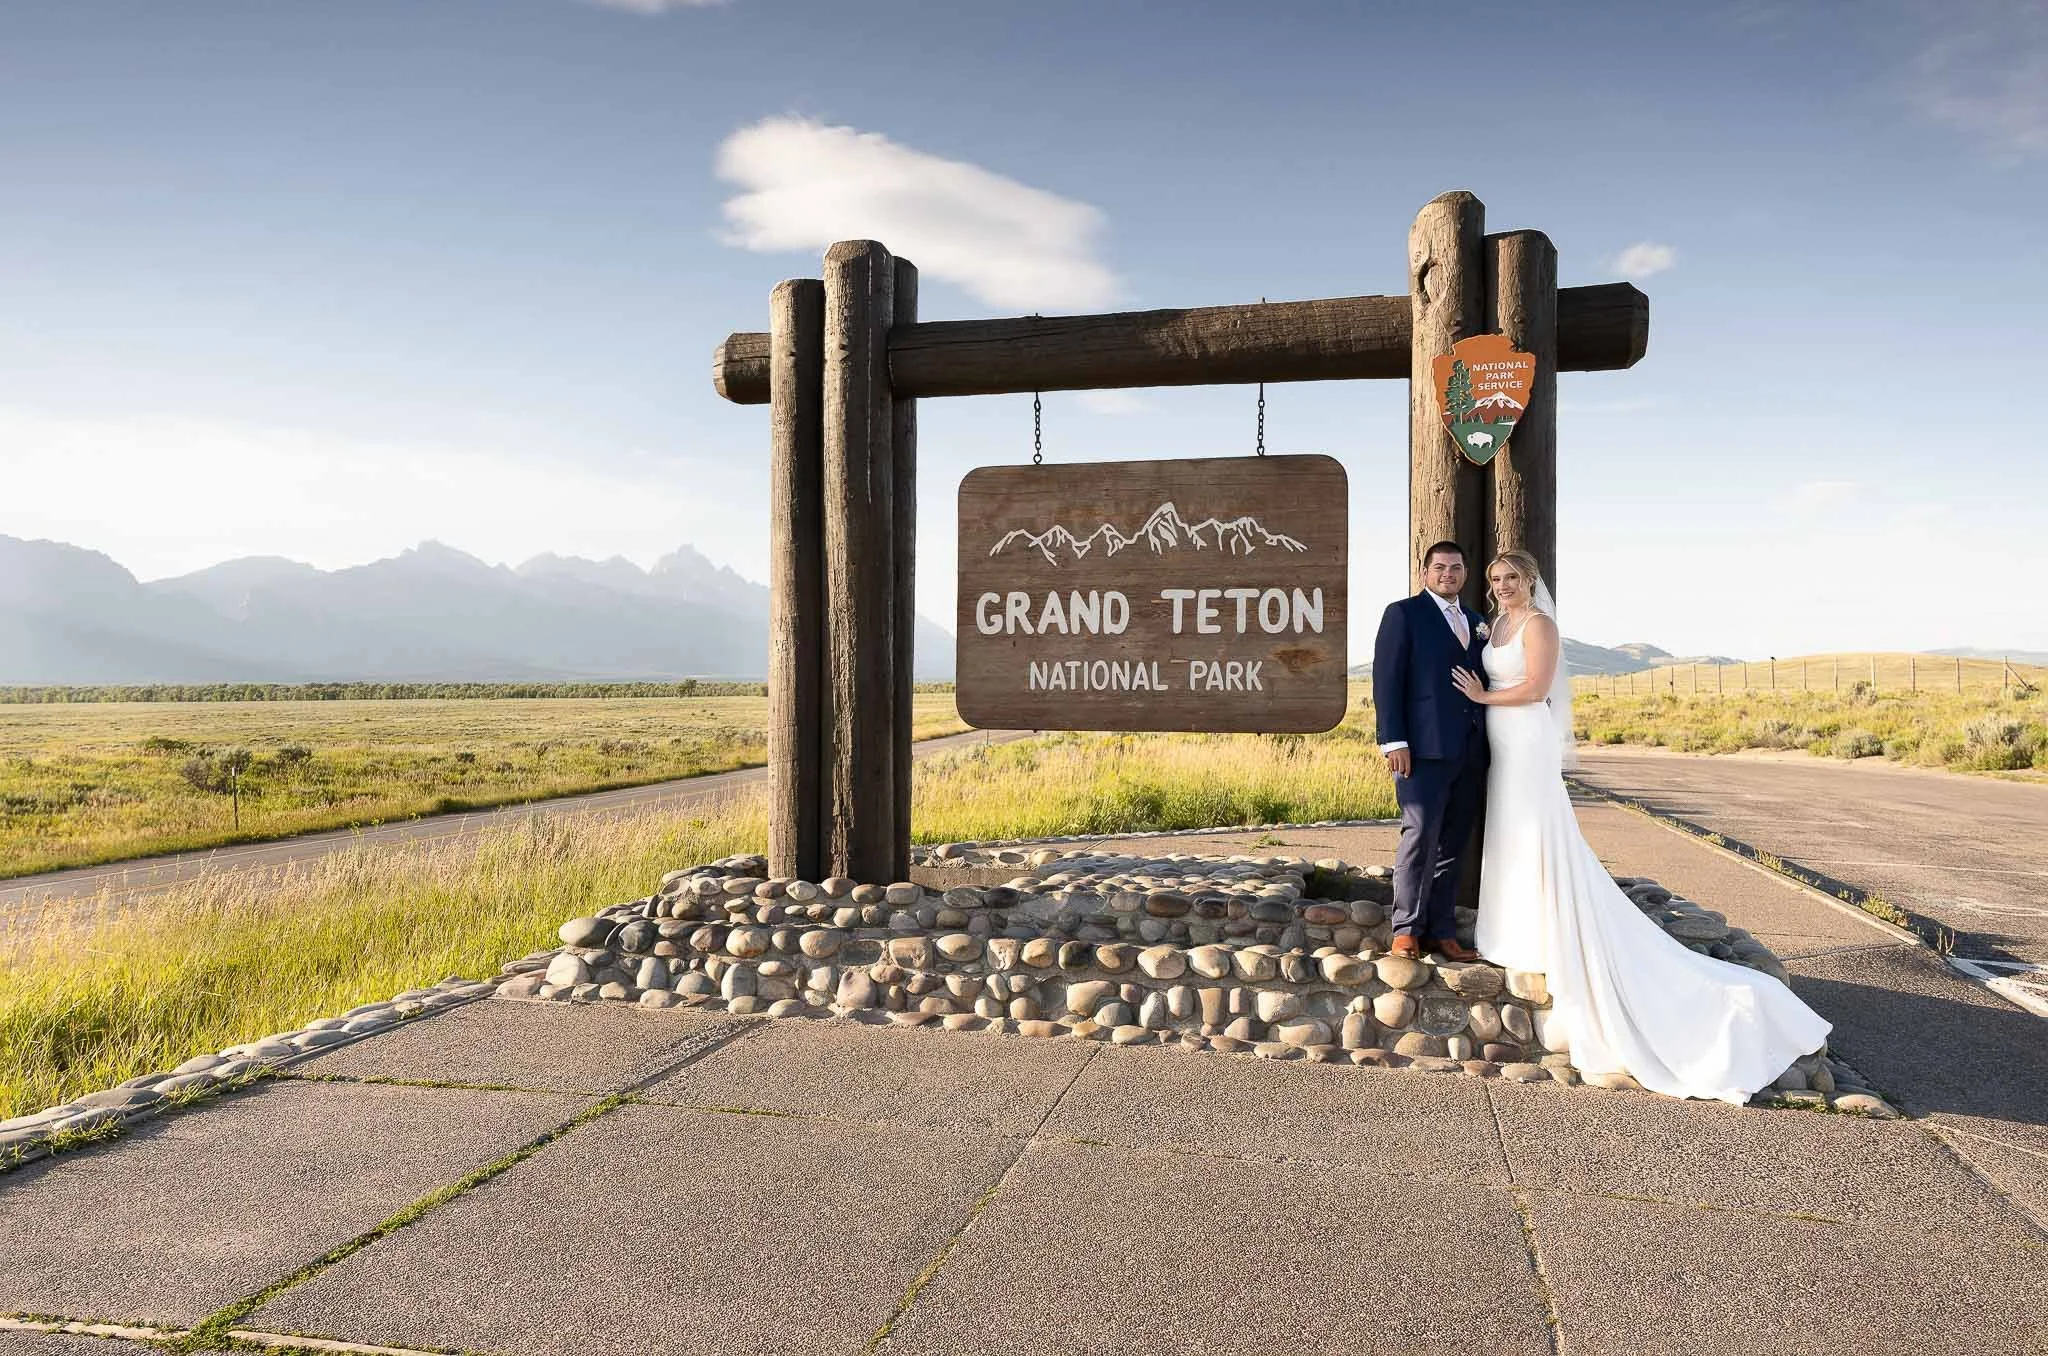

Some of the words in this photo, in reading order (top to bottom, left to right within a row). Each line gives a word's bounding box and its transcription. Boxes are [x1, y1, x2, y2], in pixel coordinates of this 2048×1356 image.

[1472, 361, 1529, 371] NATIONAL
[1486, 371, 1515, 380] PARK
[1478, 380, 1524, 391] SERVICE
[975, 590, 1130, 635] GRAND
[1160, 587, 1324, 634] TETON
[1029, 660, 1169, 691] NATIONAL
[1189, 660, 1264, 691] PARK
